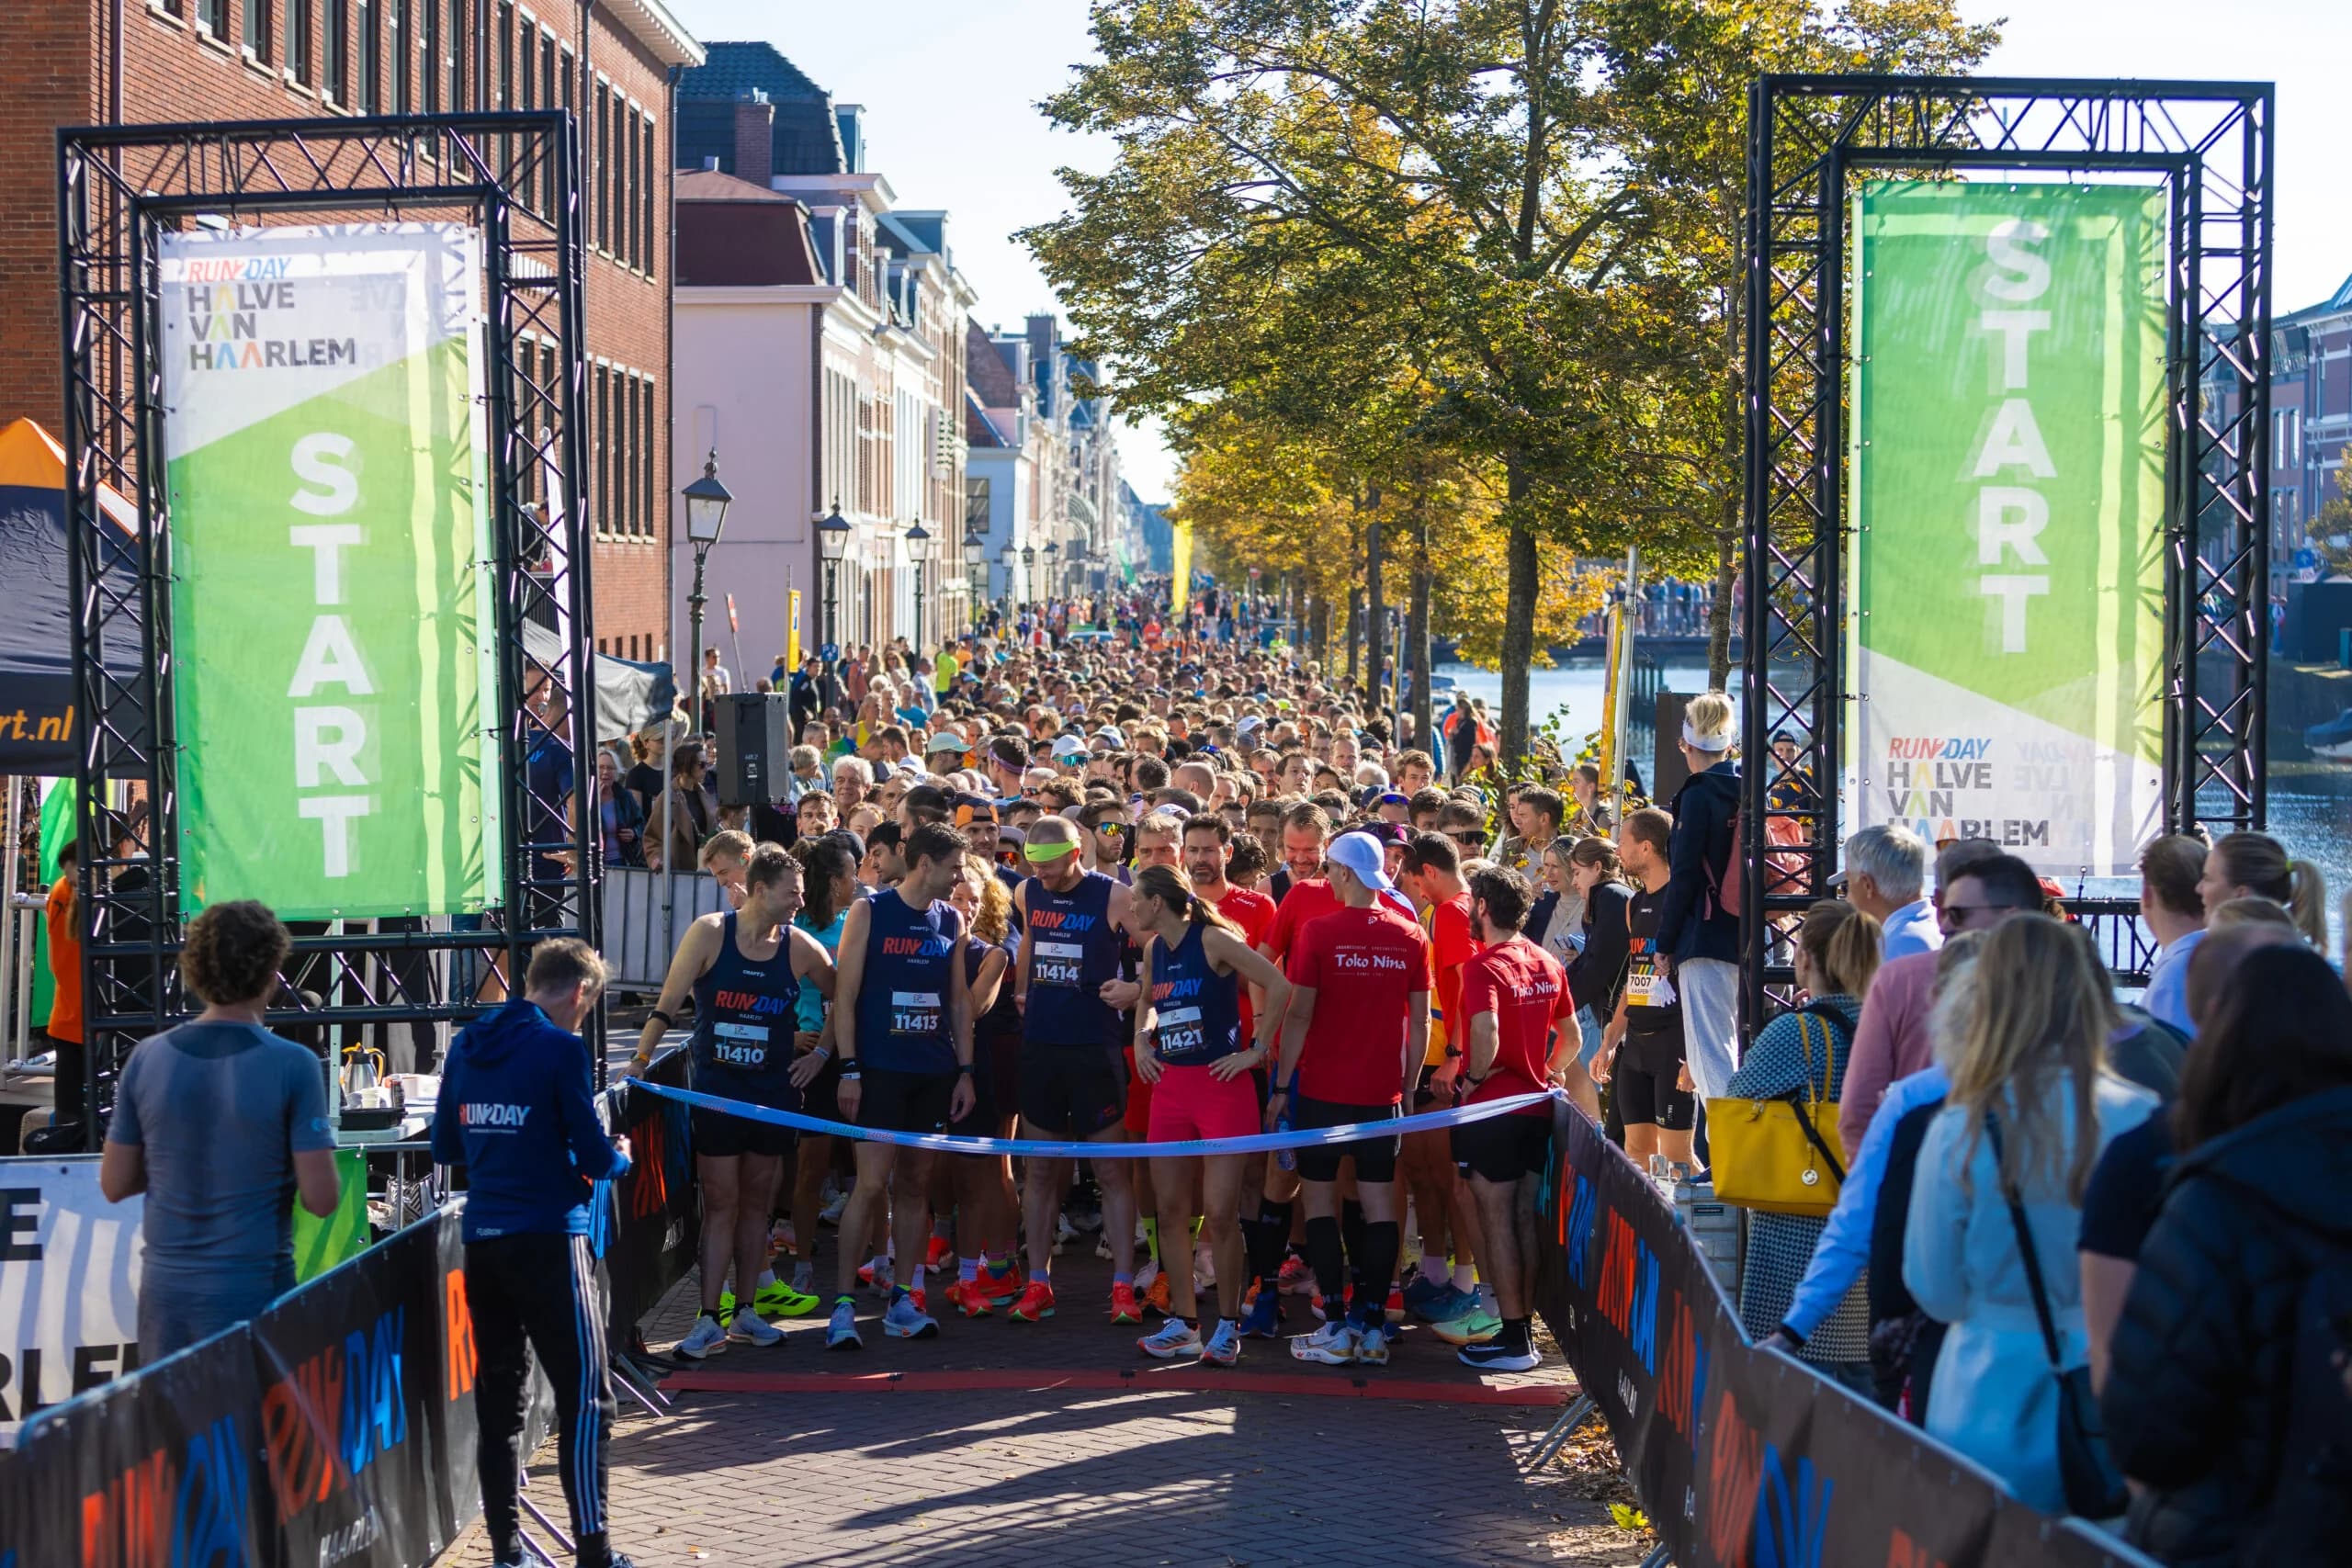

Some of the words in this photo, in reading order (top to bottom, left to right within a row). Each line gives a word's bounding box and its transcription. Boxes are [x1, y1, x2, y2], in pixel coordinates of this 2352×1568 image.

[187, 282, 295, 312] HALVE
[188, 313, 257, 342] VAN
[190, 338, 356, 371] HAARLEM
[1973, 219, 2058, 653] START
[287, 432, 375, 878] START
[1887, 761, 1992, 789] HALVE
[1887, 790, 1953, 817] VAN
[1035, 964, 1079, 981] 11414
[1334, 953, 1369, 968] Toko
[1373, 954, 1407, 970] Nina
[1510, 982, 1534, 998] Toko
[1630, 976, 1651, 987] 7007
[894, 1014, 938, 1030] 11413
[1160, 1029, 1203, 1051] 11421
[714, 1043, 764, 1064] 11410
[459, 1102, 531, 1126] RUN2DAY
